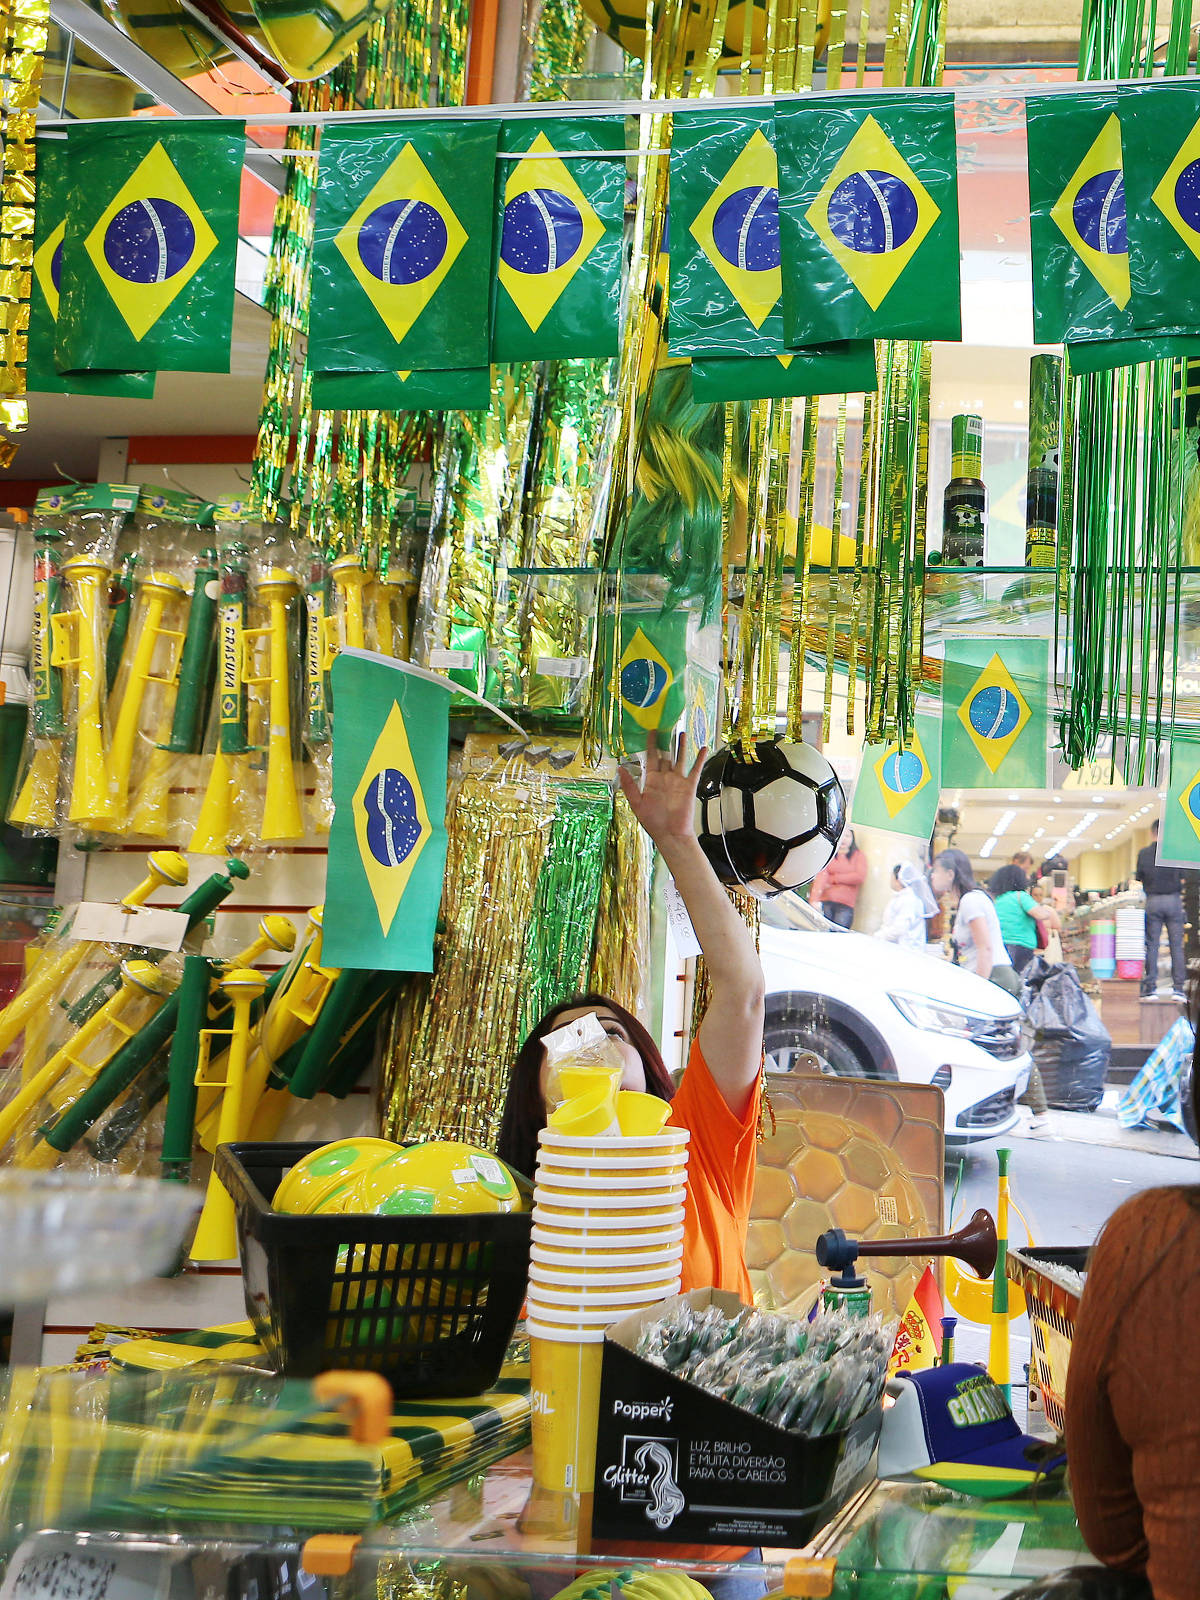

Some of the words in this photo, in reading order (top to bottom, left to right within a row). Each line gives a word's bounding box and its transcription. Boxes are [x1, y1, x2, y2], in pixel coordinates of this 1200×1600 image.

[613, 1399, 663, 1420] Popper
[714, 1441, 752, 1454] BRILHO
[689, 1453, 697, 1465] E
[698, 1454, 731, 1467] MUITA
[732, 1454, 786, 1469] DIVERSÃO
[603, 1464, 651, 1489] Glitter
[689, 1466, 716, 1479] PARA
[717, 1468, 735, 1480] OS
[736, 1469, 787, 1482] CABELOS
